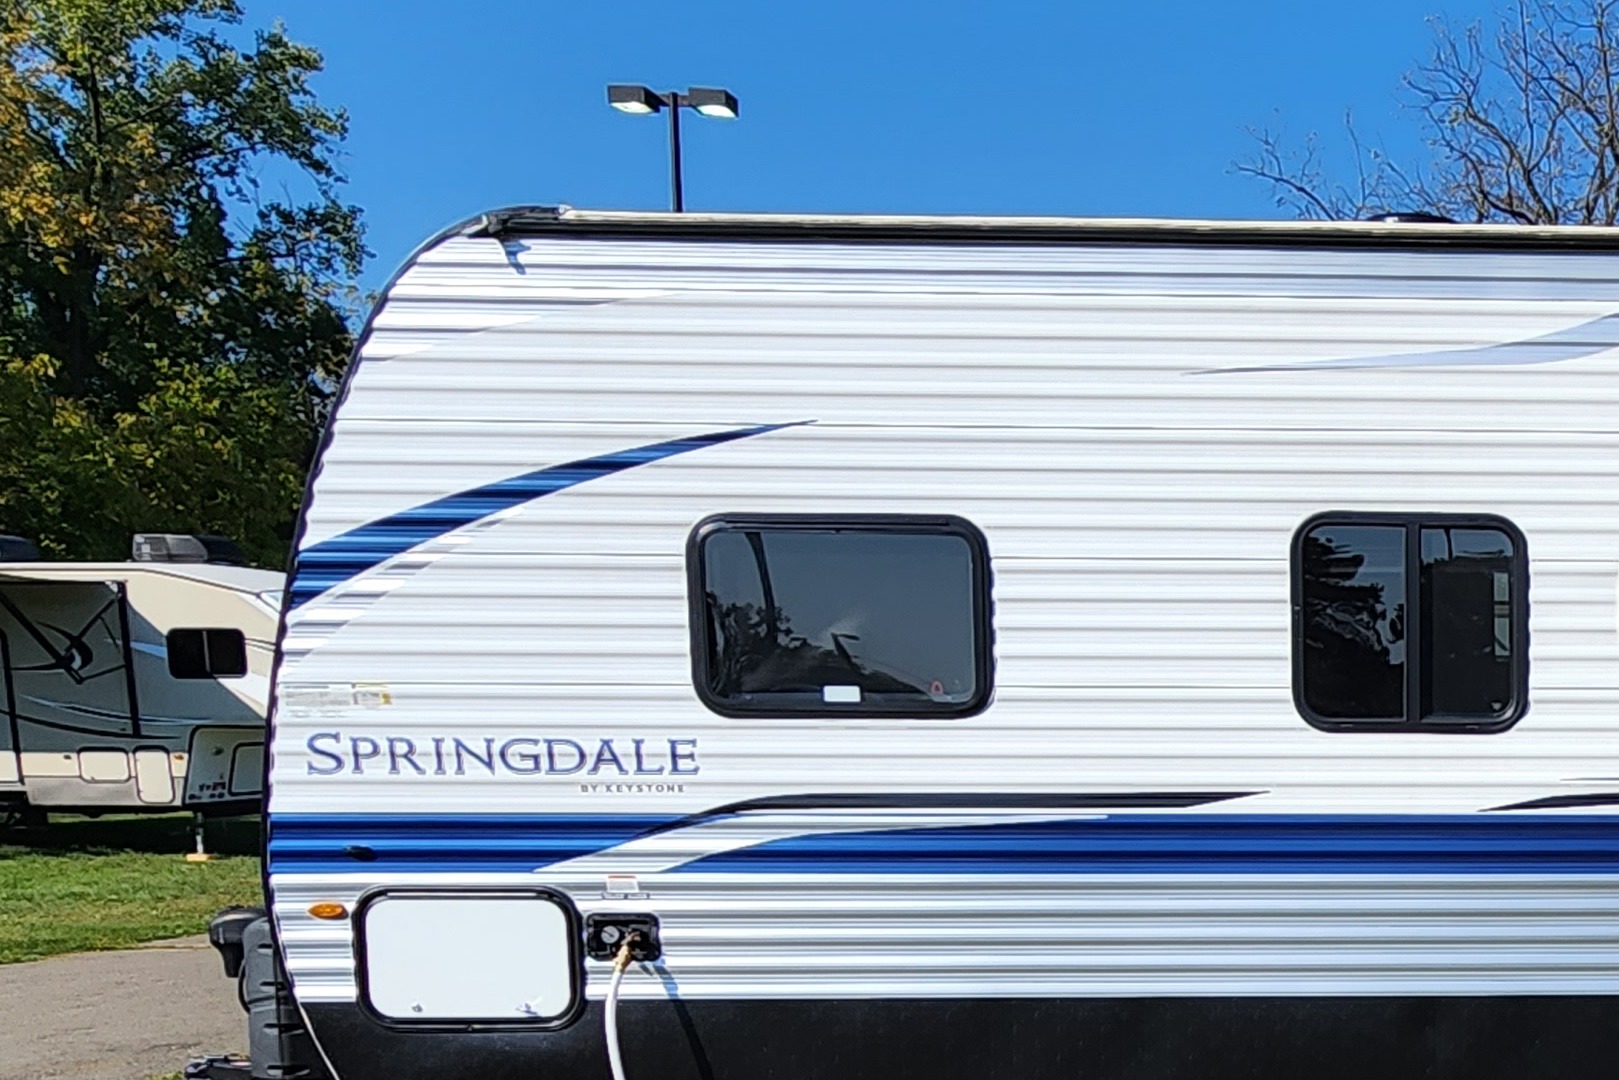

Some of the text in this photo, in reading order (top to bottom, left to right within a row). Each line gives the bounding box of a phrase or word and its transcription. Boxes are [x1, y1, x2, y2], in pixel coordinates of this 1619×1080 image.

[306, 731, 701, 776] SPRINGDALE
[580, 784, 685, 793] BY KEYSTONE
